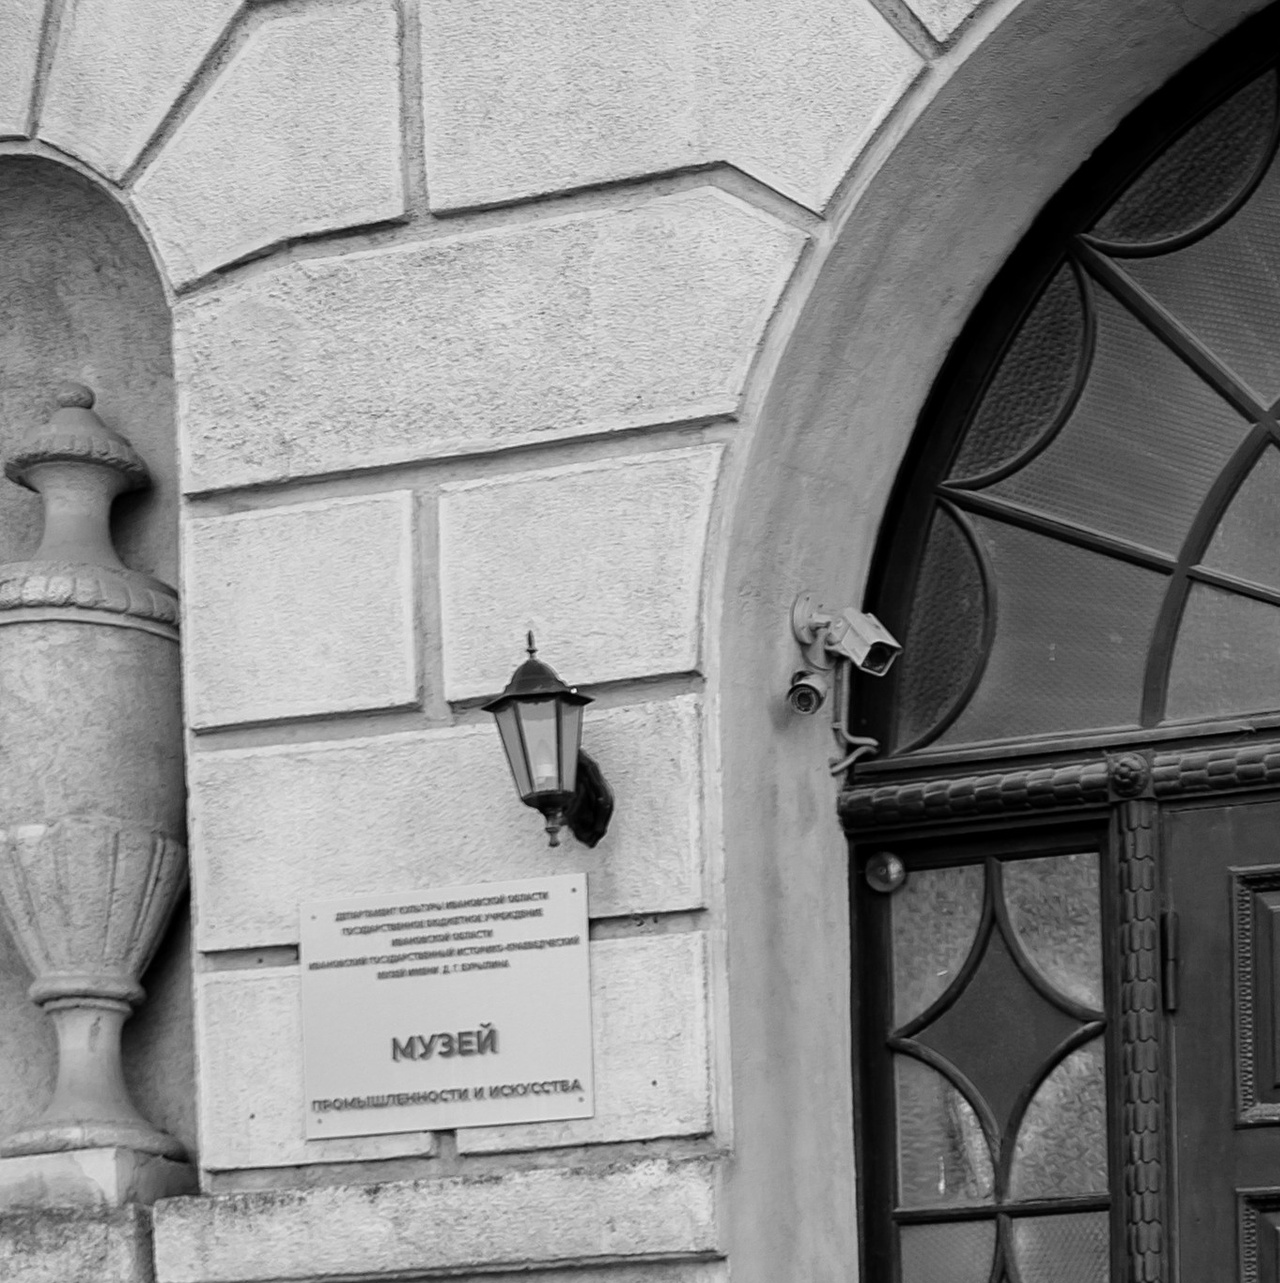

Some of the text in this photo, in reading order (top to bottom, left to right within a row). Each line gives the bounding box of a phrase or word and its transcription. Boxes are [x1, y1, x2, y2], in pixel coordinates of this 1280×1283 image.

[391, 1022, 500, 1062] МУЗЕЙ
[311, 1079, 583, 1112] ПРОМЫШЛЕННОСТИ И ИСКУССТВА
